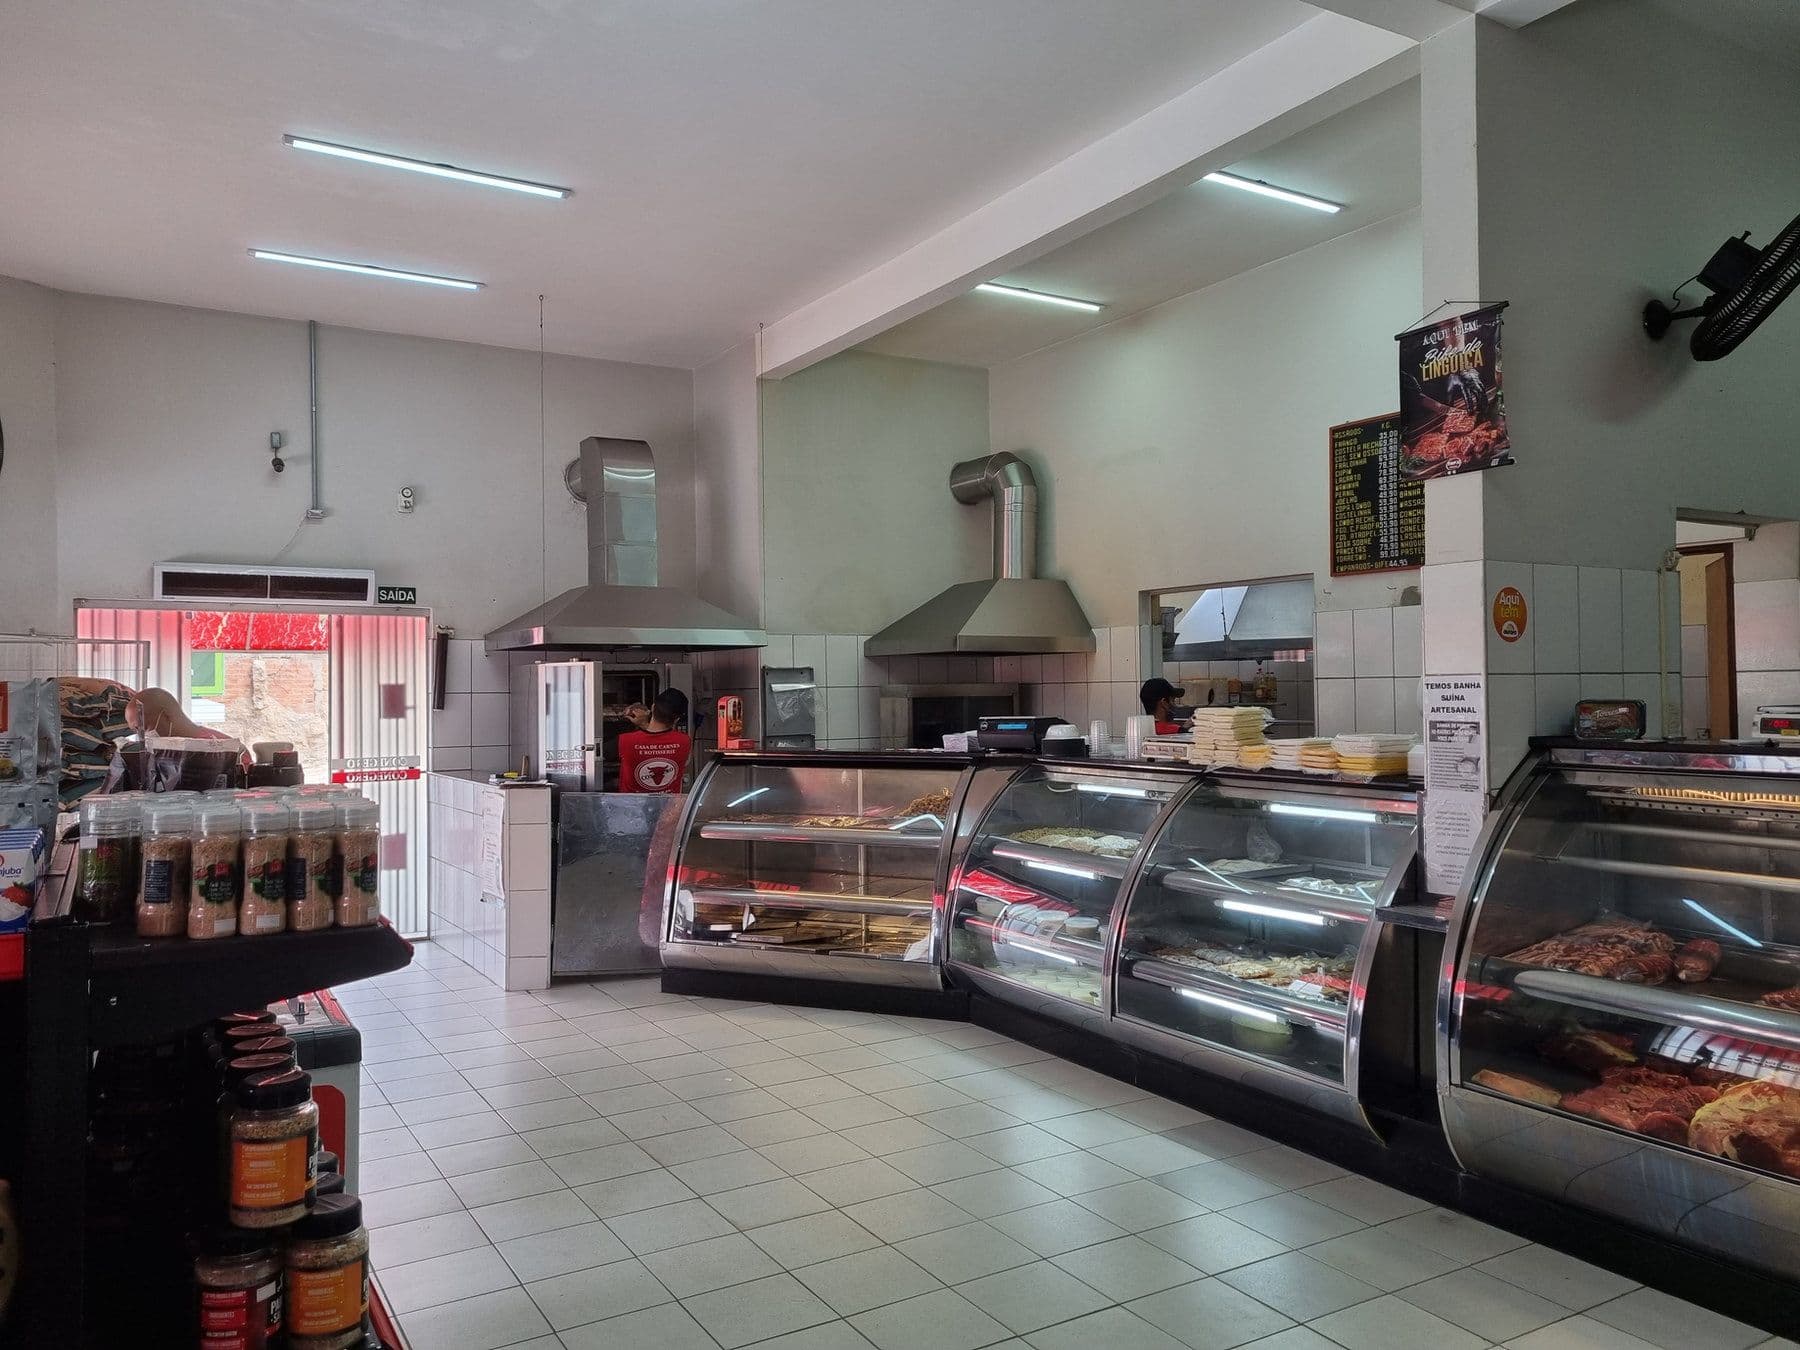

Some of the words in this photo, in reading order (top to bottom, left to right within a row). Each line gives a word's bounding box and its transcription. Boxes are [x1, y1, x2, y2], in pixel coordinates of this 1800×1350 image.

[379, 587, 415, 601] SAÍDA
[1500, 591, 1520, 608] Aqui
[1440, 694, 1466, 702] SUÍNA
